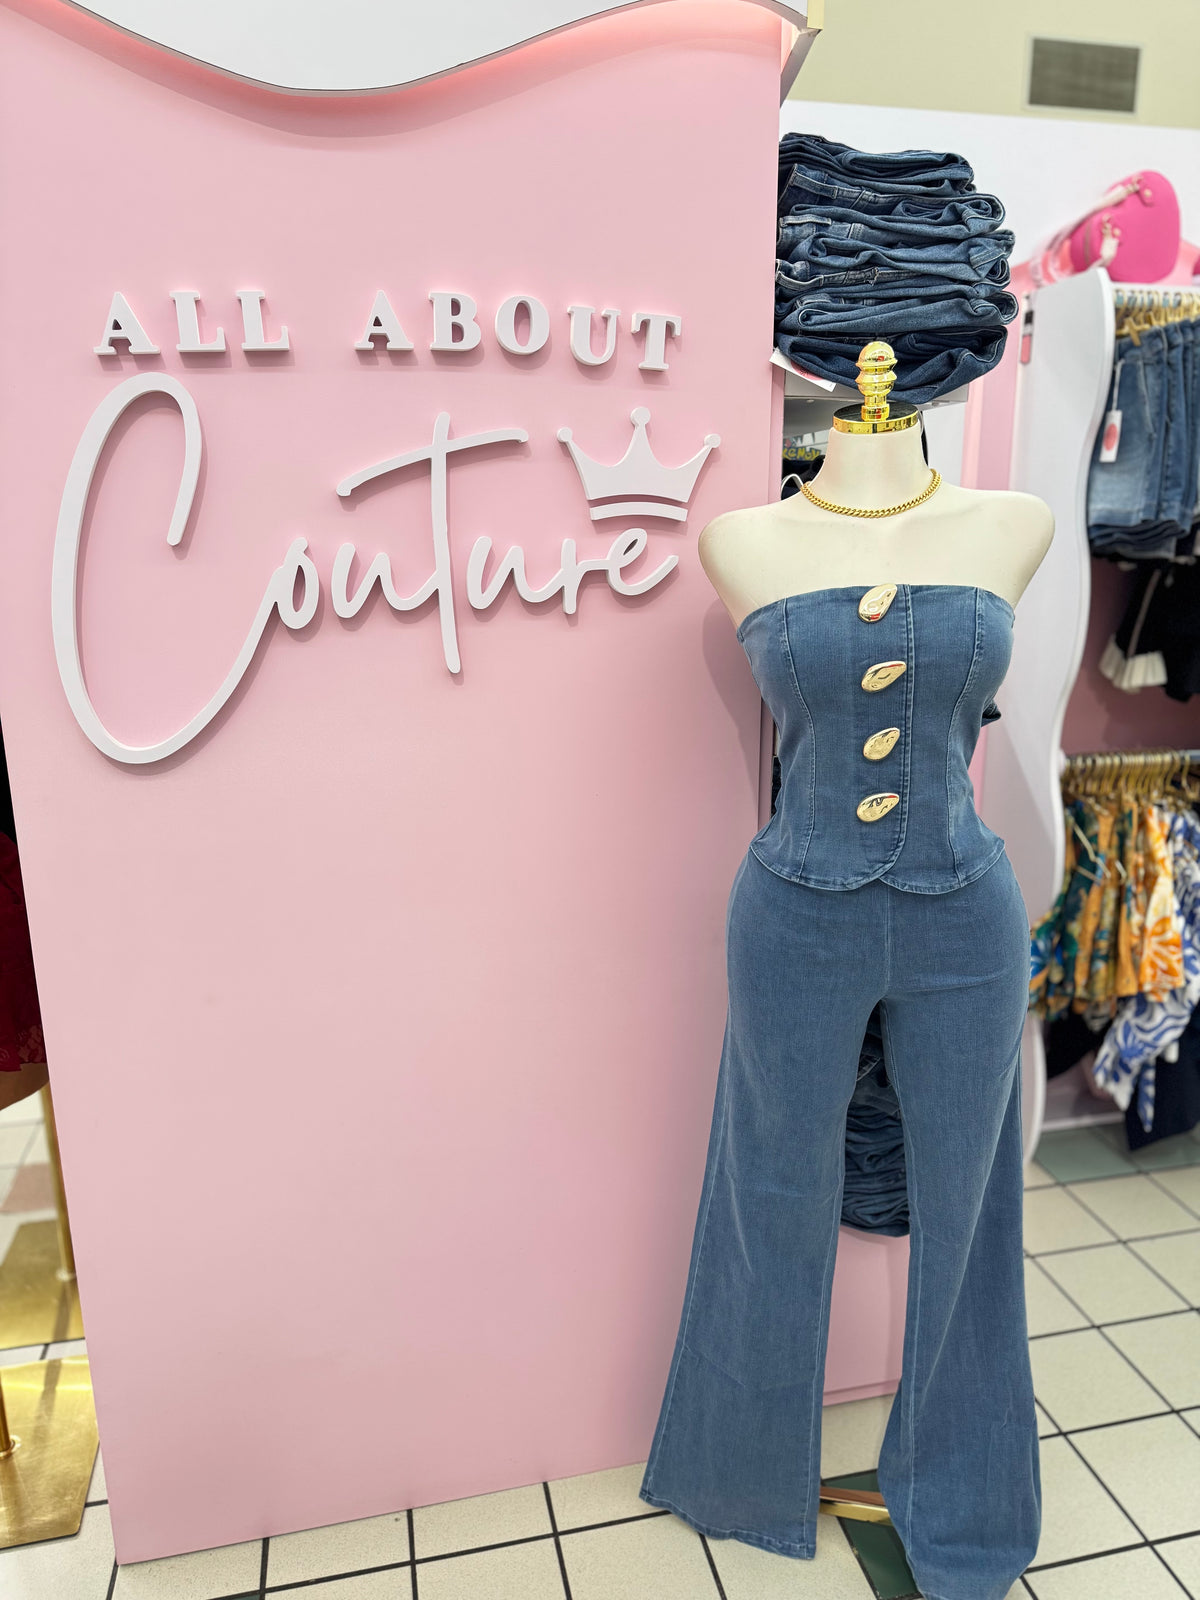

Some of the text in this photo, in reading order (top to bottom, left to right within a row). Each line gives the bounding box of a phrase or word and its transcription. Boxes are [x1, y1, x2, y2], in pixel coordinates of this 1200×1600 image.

[94, 290, 682, 372] ALL ABOUT
[51, 371, 678, 764] Couture
